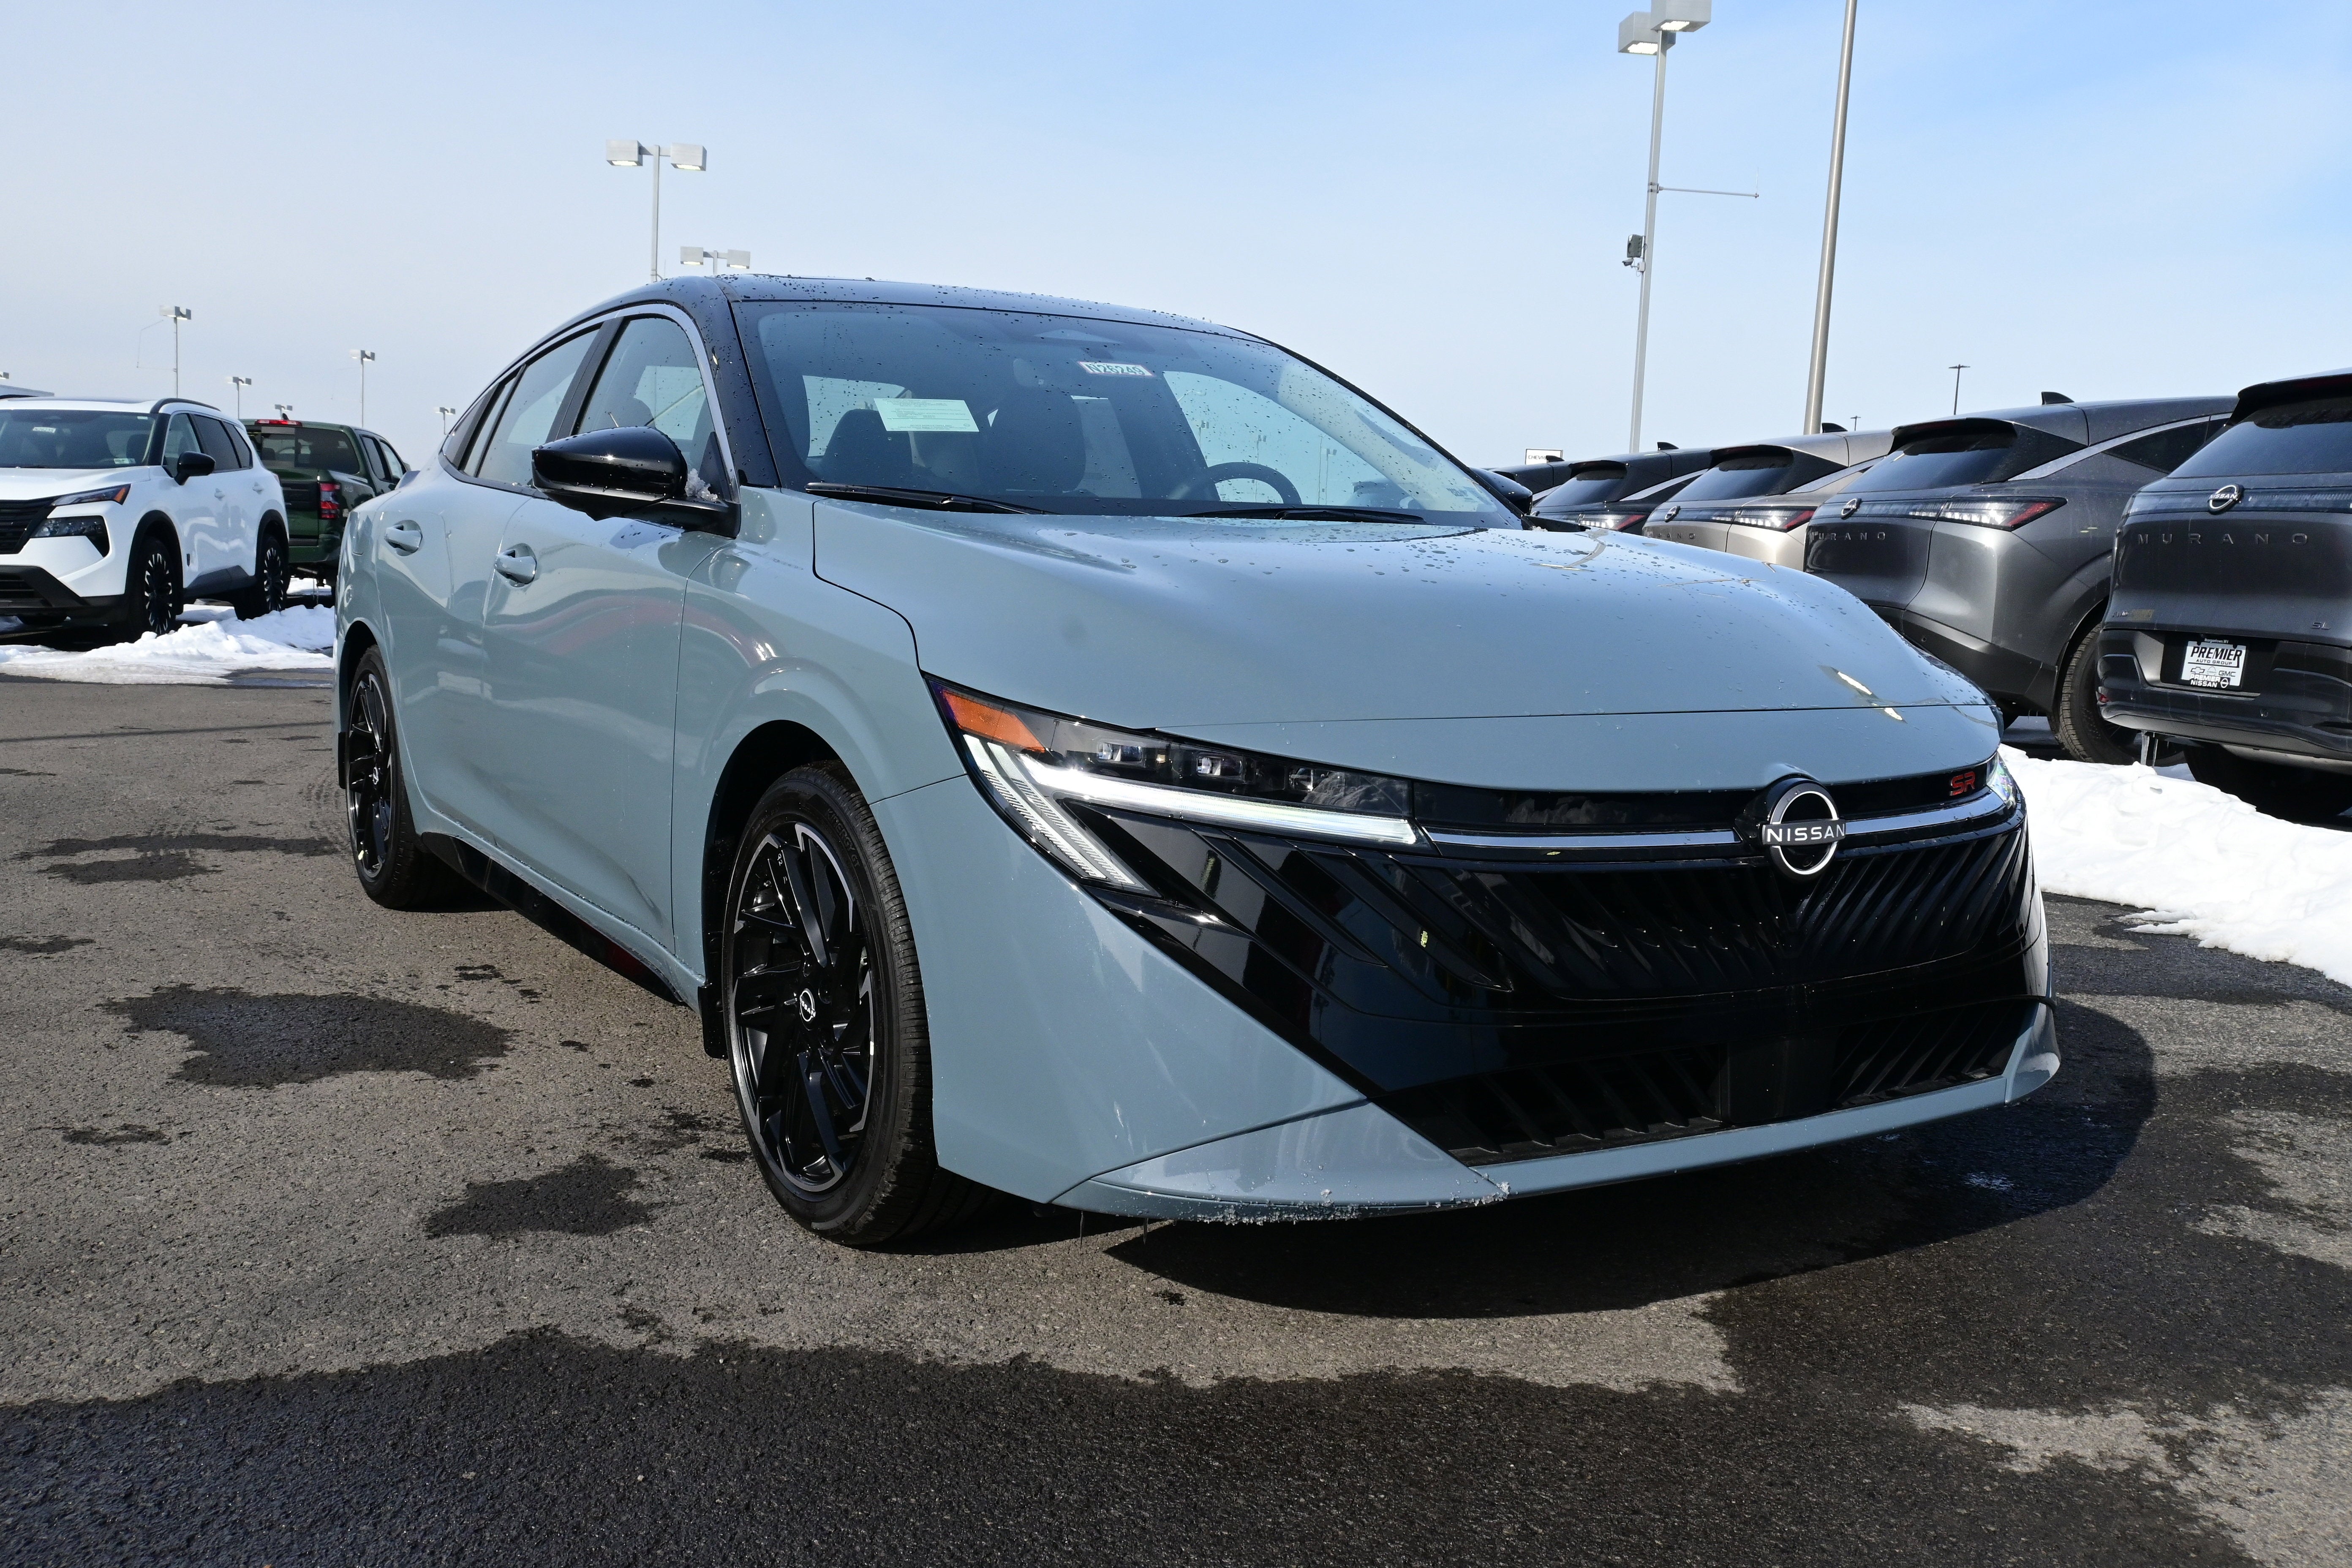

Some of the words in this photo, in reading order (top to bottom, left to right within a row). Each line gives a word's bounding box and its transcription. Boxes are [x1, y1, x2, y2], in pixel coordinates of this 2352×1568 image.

[1085, 364, 1145, 375] N26249
[2137, 533, 2308, 544] MURANO
[2191, 646, 2243, 662] PREMIER
[2190, 674, 2221, 682] PREMIER
[2190, 680, 2218, 688] NISSAN
[1949, 771, 1976, 796] SR
[1767, 823, 1845, 842] NISSAN
